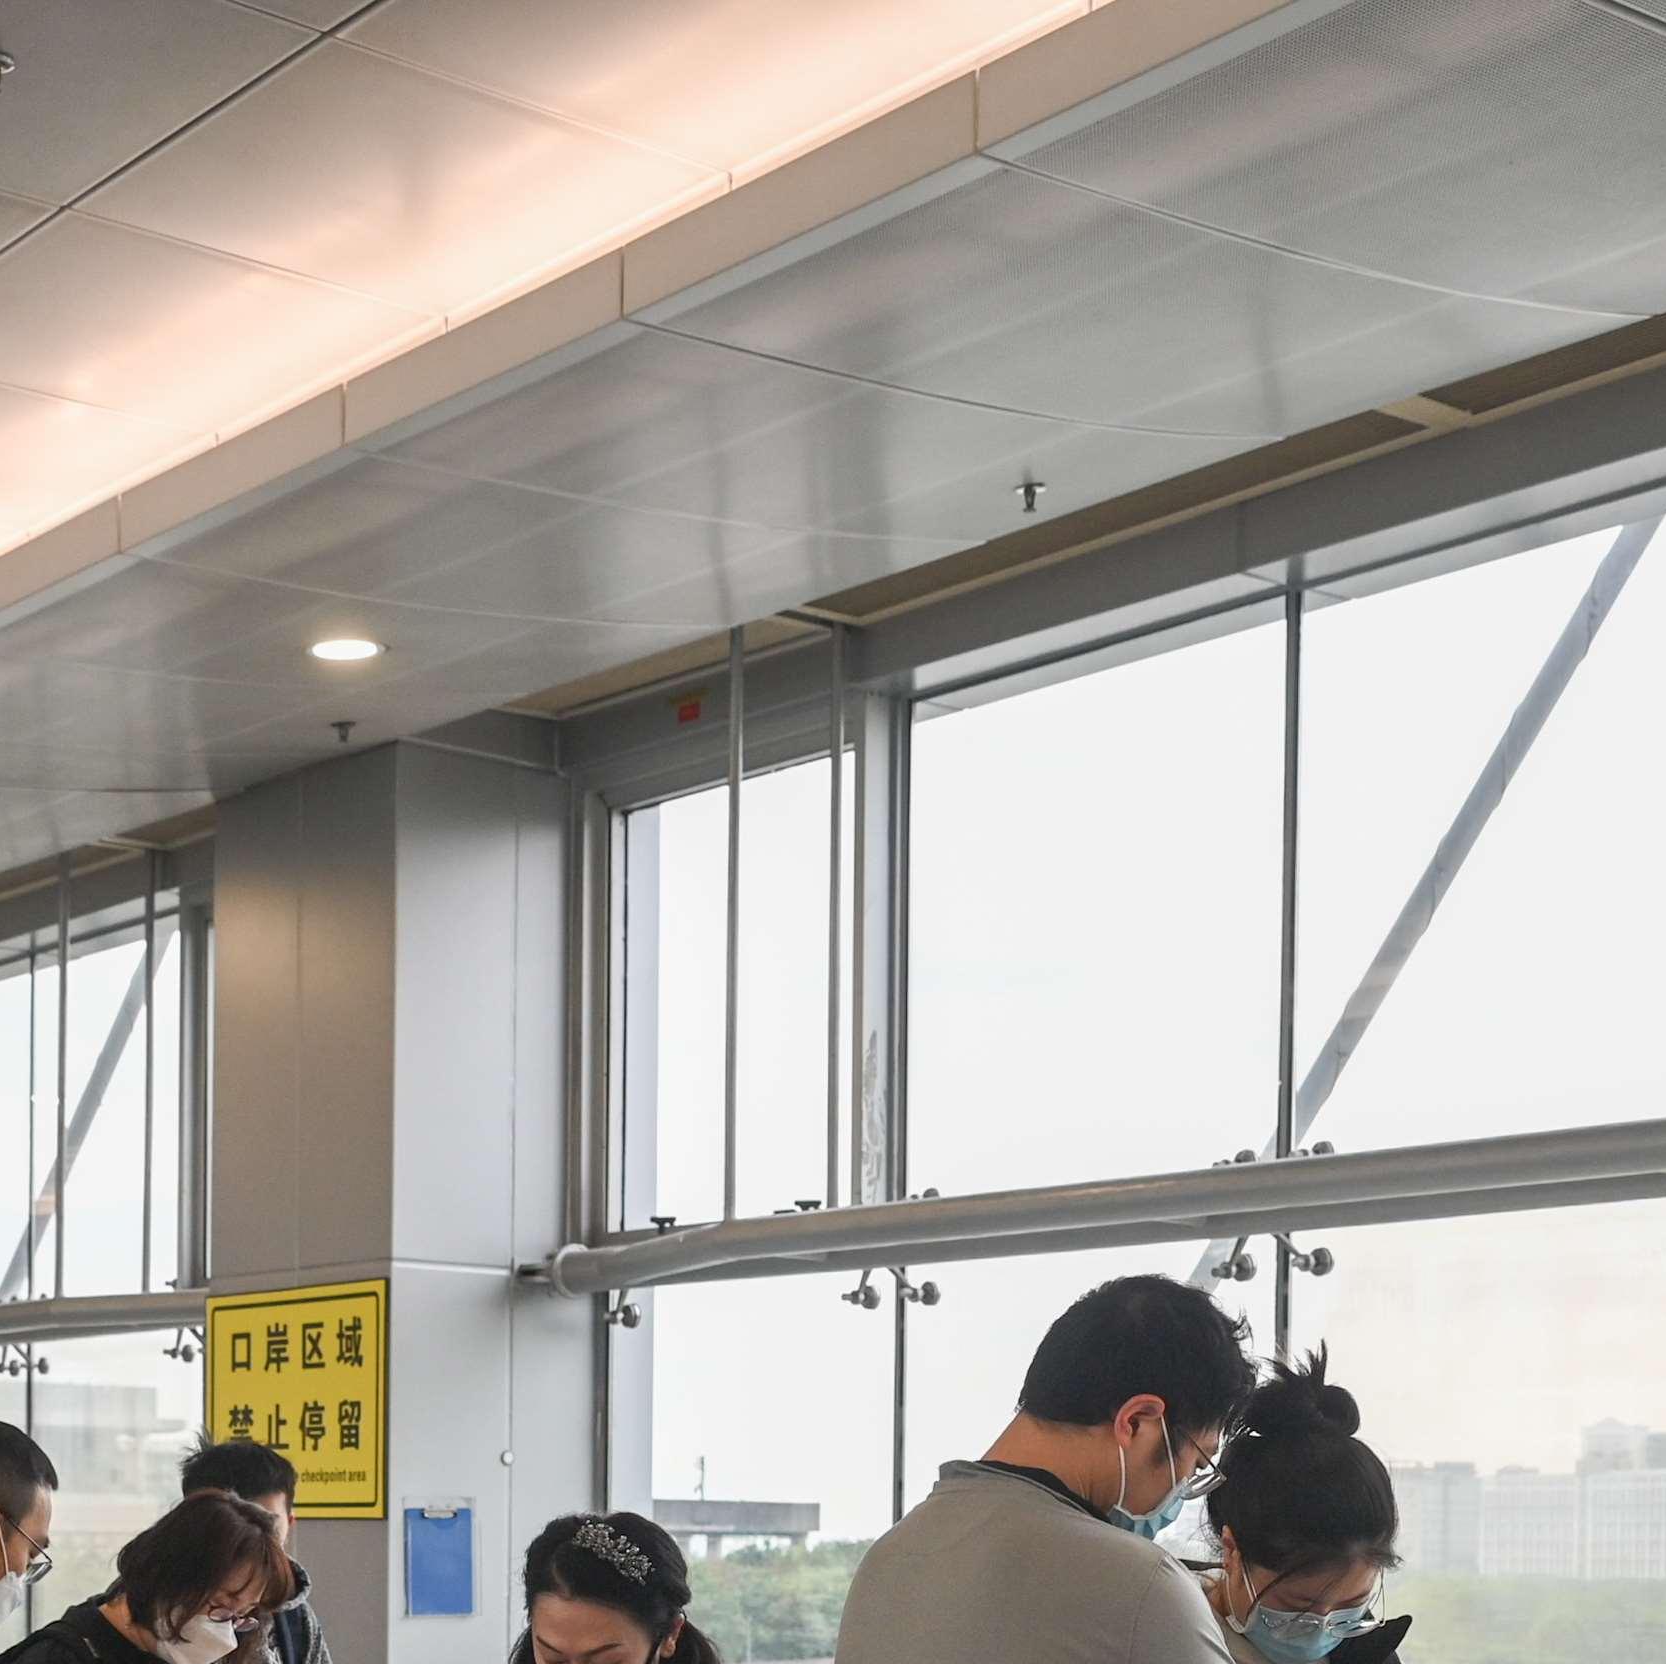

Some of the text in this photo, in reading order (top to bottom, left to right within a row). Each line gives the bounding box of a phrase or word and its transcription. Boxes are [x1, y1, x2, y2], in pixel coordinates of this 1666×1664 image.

[231, 1316, 364, 1373] 口岸区域
[229, 1400, 361, 1450] 禁止停留
[301, 1467, 346, 1485] checkpoint
[348, 1470, 366, 1482] area
